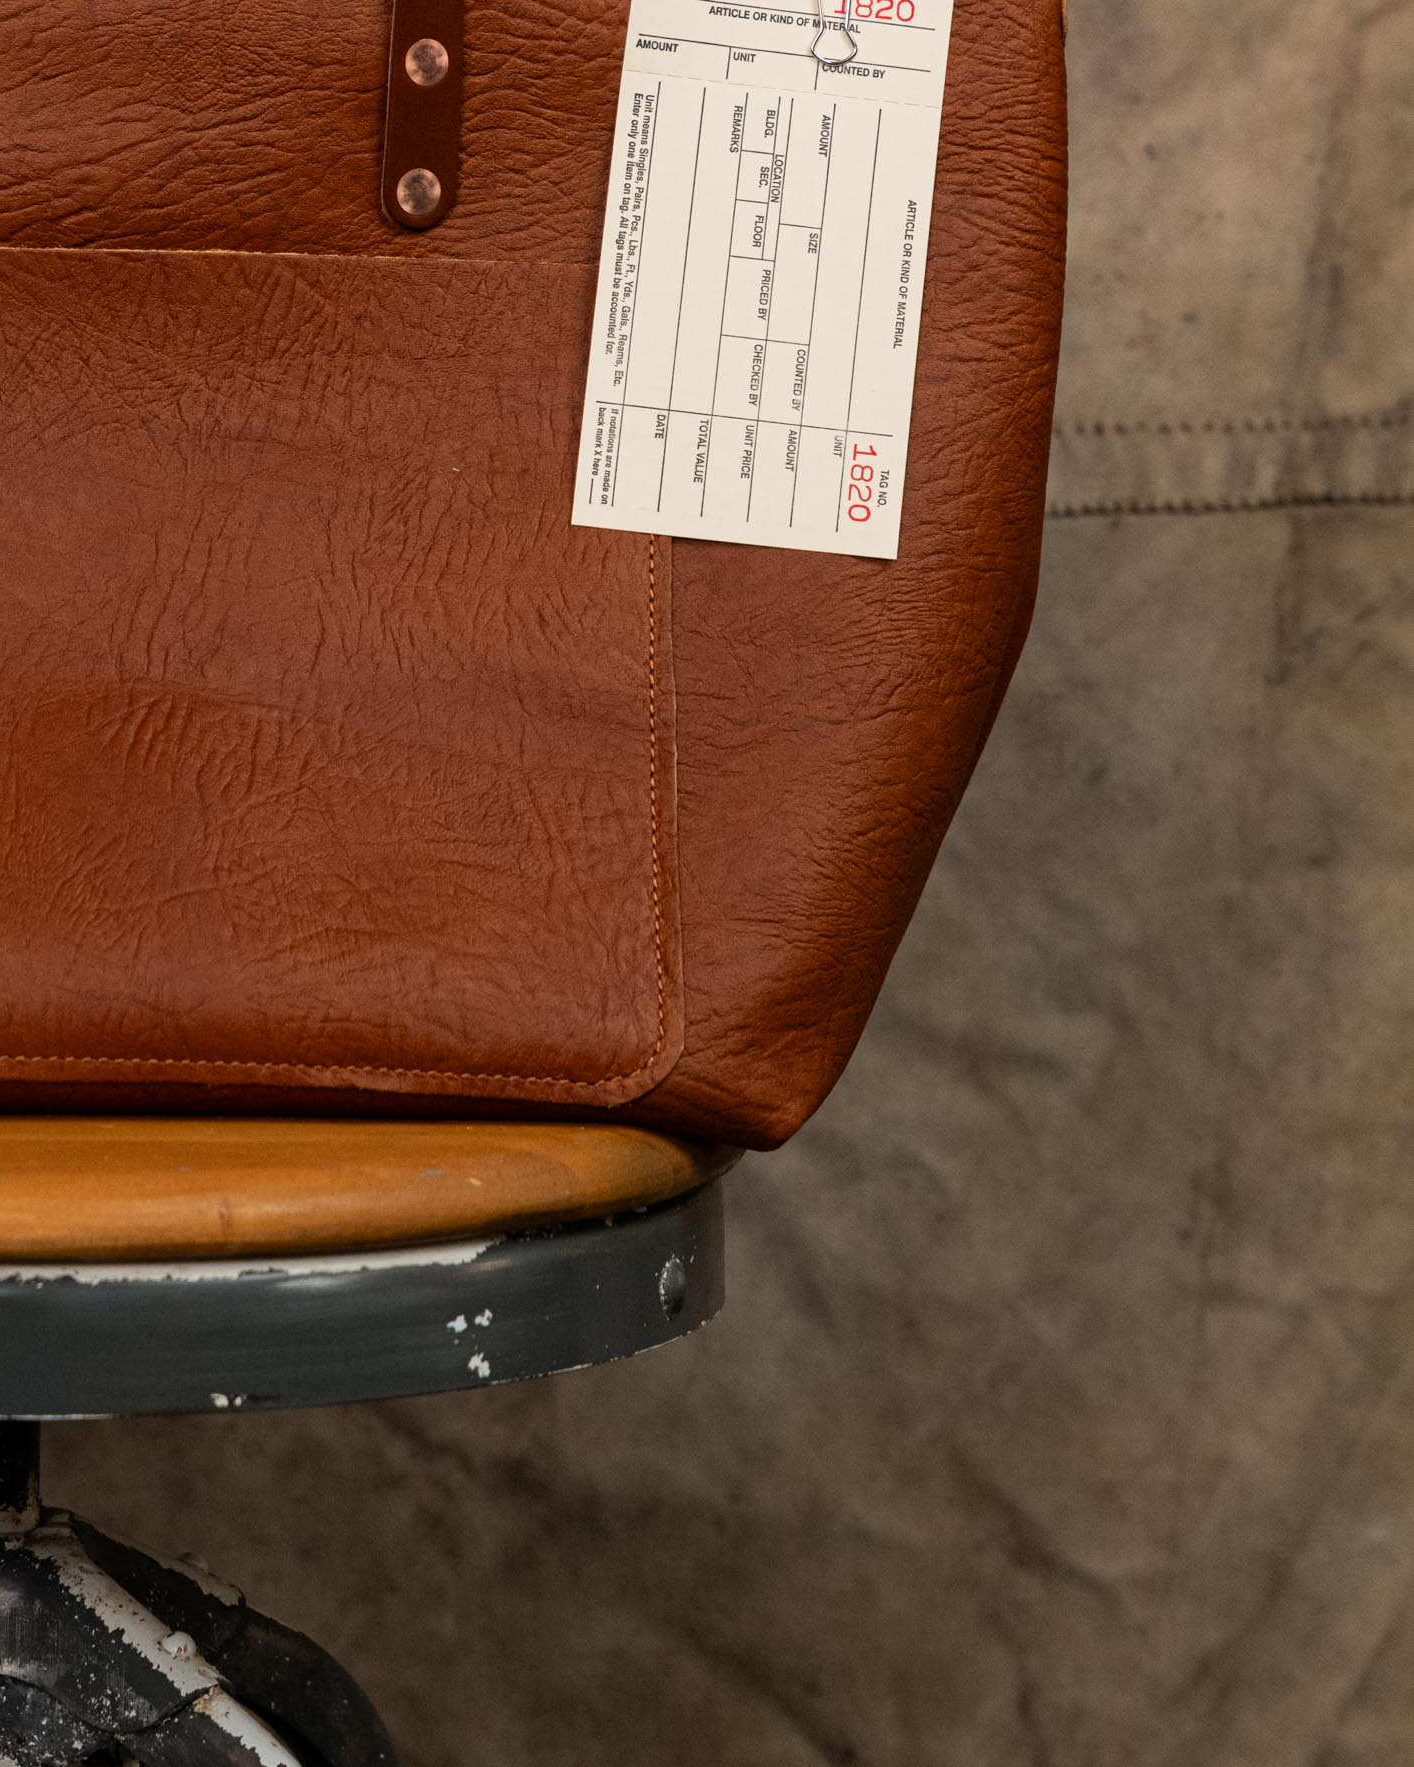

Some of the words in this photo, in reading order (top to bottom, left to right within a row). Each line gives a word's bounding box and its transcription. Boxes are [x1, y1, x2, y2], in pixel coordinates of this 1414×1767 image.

[708, 5, 750, 19] ARTICLE
[752, 11, 767, 21] OR
[769, 13, 793, 24] KIND
[796, 16, 810, 26] OF
[812, 18, 861, 33] MATERAL
[635, 38, 679, 52] AMOUNT
[732, 51, 756, 62] UNIT
[821, 63, 869, 76] COUNTED
[872, 68, 885, 78] BY
[632, 92, 643, 118] Enter
[644, 94, 655, 113] Unit
[627, 119, 639, 140] only
[640, 114, 650, 146] means
[729, 105, 743, 153] REMARKS
[764, 109, 776, 138] BLDG.
[818, 114, 831, 158] AMOUNT
[627, 141, 636, 159] one
[624, 160, 634, 181] item
[758, 166, 769, 189] SEC.
[770, 154, 784, 203] LOCATION
[623, 182, 631, 195] on
[619, 197, 631, 214] tag.
[619, 215, 629, 229] All
[751, 214, 764, 248] FLOOR
[904, 199, 917, 241] ARTICLE
[615, 230, 627, 251] tags
[807, 232, 818, 255] SIZE
[902, 242, 912, 258] OR
[613, 252, 623, 276] must
[899, 259, 910, 284] KIND
[612, 277, 622, 289] be
[758, 269, 771, 306] PRICED
[898, 285, 908, 300] OF
[606, 290, 619, 339] accounted
[757, 307, 767, 321] BY
[892, 301, 906, 350] MATERIAL
[604, 340, 615, 355] for.
[613, 369, 624, 387] Etc.
[749, 344, 763, 392] CHECKED
[792, 348, 806, 397] COUNTED
[748, 393, 758, 407] BY
[791, 398, 801, 412] BY
[597, 406, 607, 427] back
[654, 414, 666, 440] DATE
[594, 427, 603, 449] mark
[606, 415, 617, 454] notations
[696, 419, 709, 450] TOTAL
[743, 424, 754, 448] UNIT
[593, 449, 602, 457] X
[785, 429, 797, 473] AMOUNT
[833, 435, 842, 459] UNIT
[591, 457, 601, 476] here
[604, 454, 612, 469] are
[693, 452, 705, 484] VALUE
[740, 449, 752, 480] PRICE
[602, 469, 610, 493] made
[847, 443, 877, 523] 1820
[878, 469, 889, 489] TAG
[600, 494, 608, 505] on
[876, 491, 887, 508] NO.
